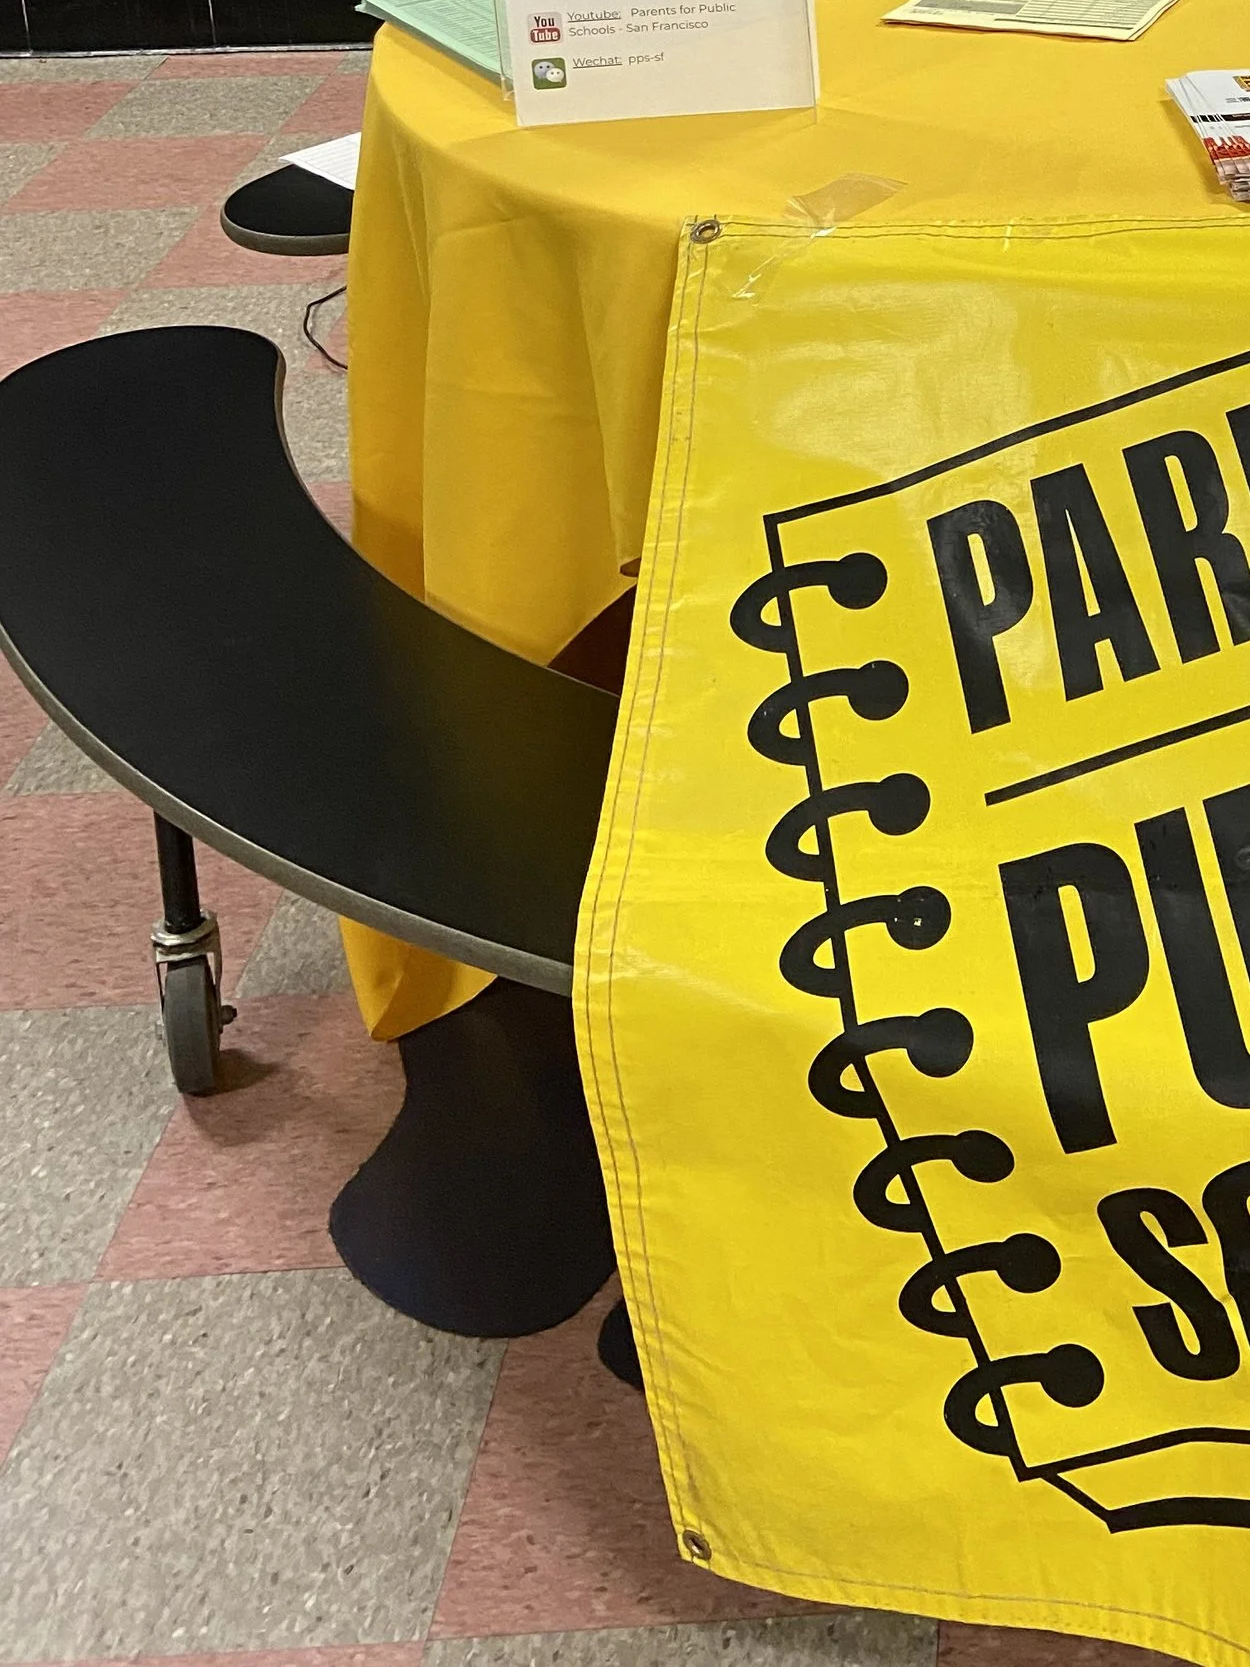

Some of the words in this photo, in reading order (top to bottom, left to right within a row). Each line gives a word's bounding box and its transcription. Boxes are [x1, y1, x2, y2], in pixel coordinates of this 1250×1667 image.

[567, 10, 621, 23] Youtube:
[631, 7, 676, 17] Parents
[679, 5, 696, 14] for
[699, 3, 736, 13] Public
[534, 16, 555, 27] You
[568, 25, 616, 37] Schools
[626, 23, 649, 33] San
[652, 20, 709, 31] Francisco
[533, 29, 558, 41] Tube
[572, 56, 622, 68] Wechat:
[628, 52, 664, 65] pps-sf
